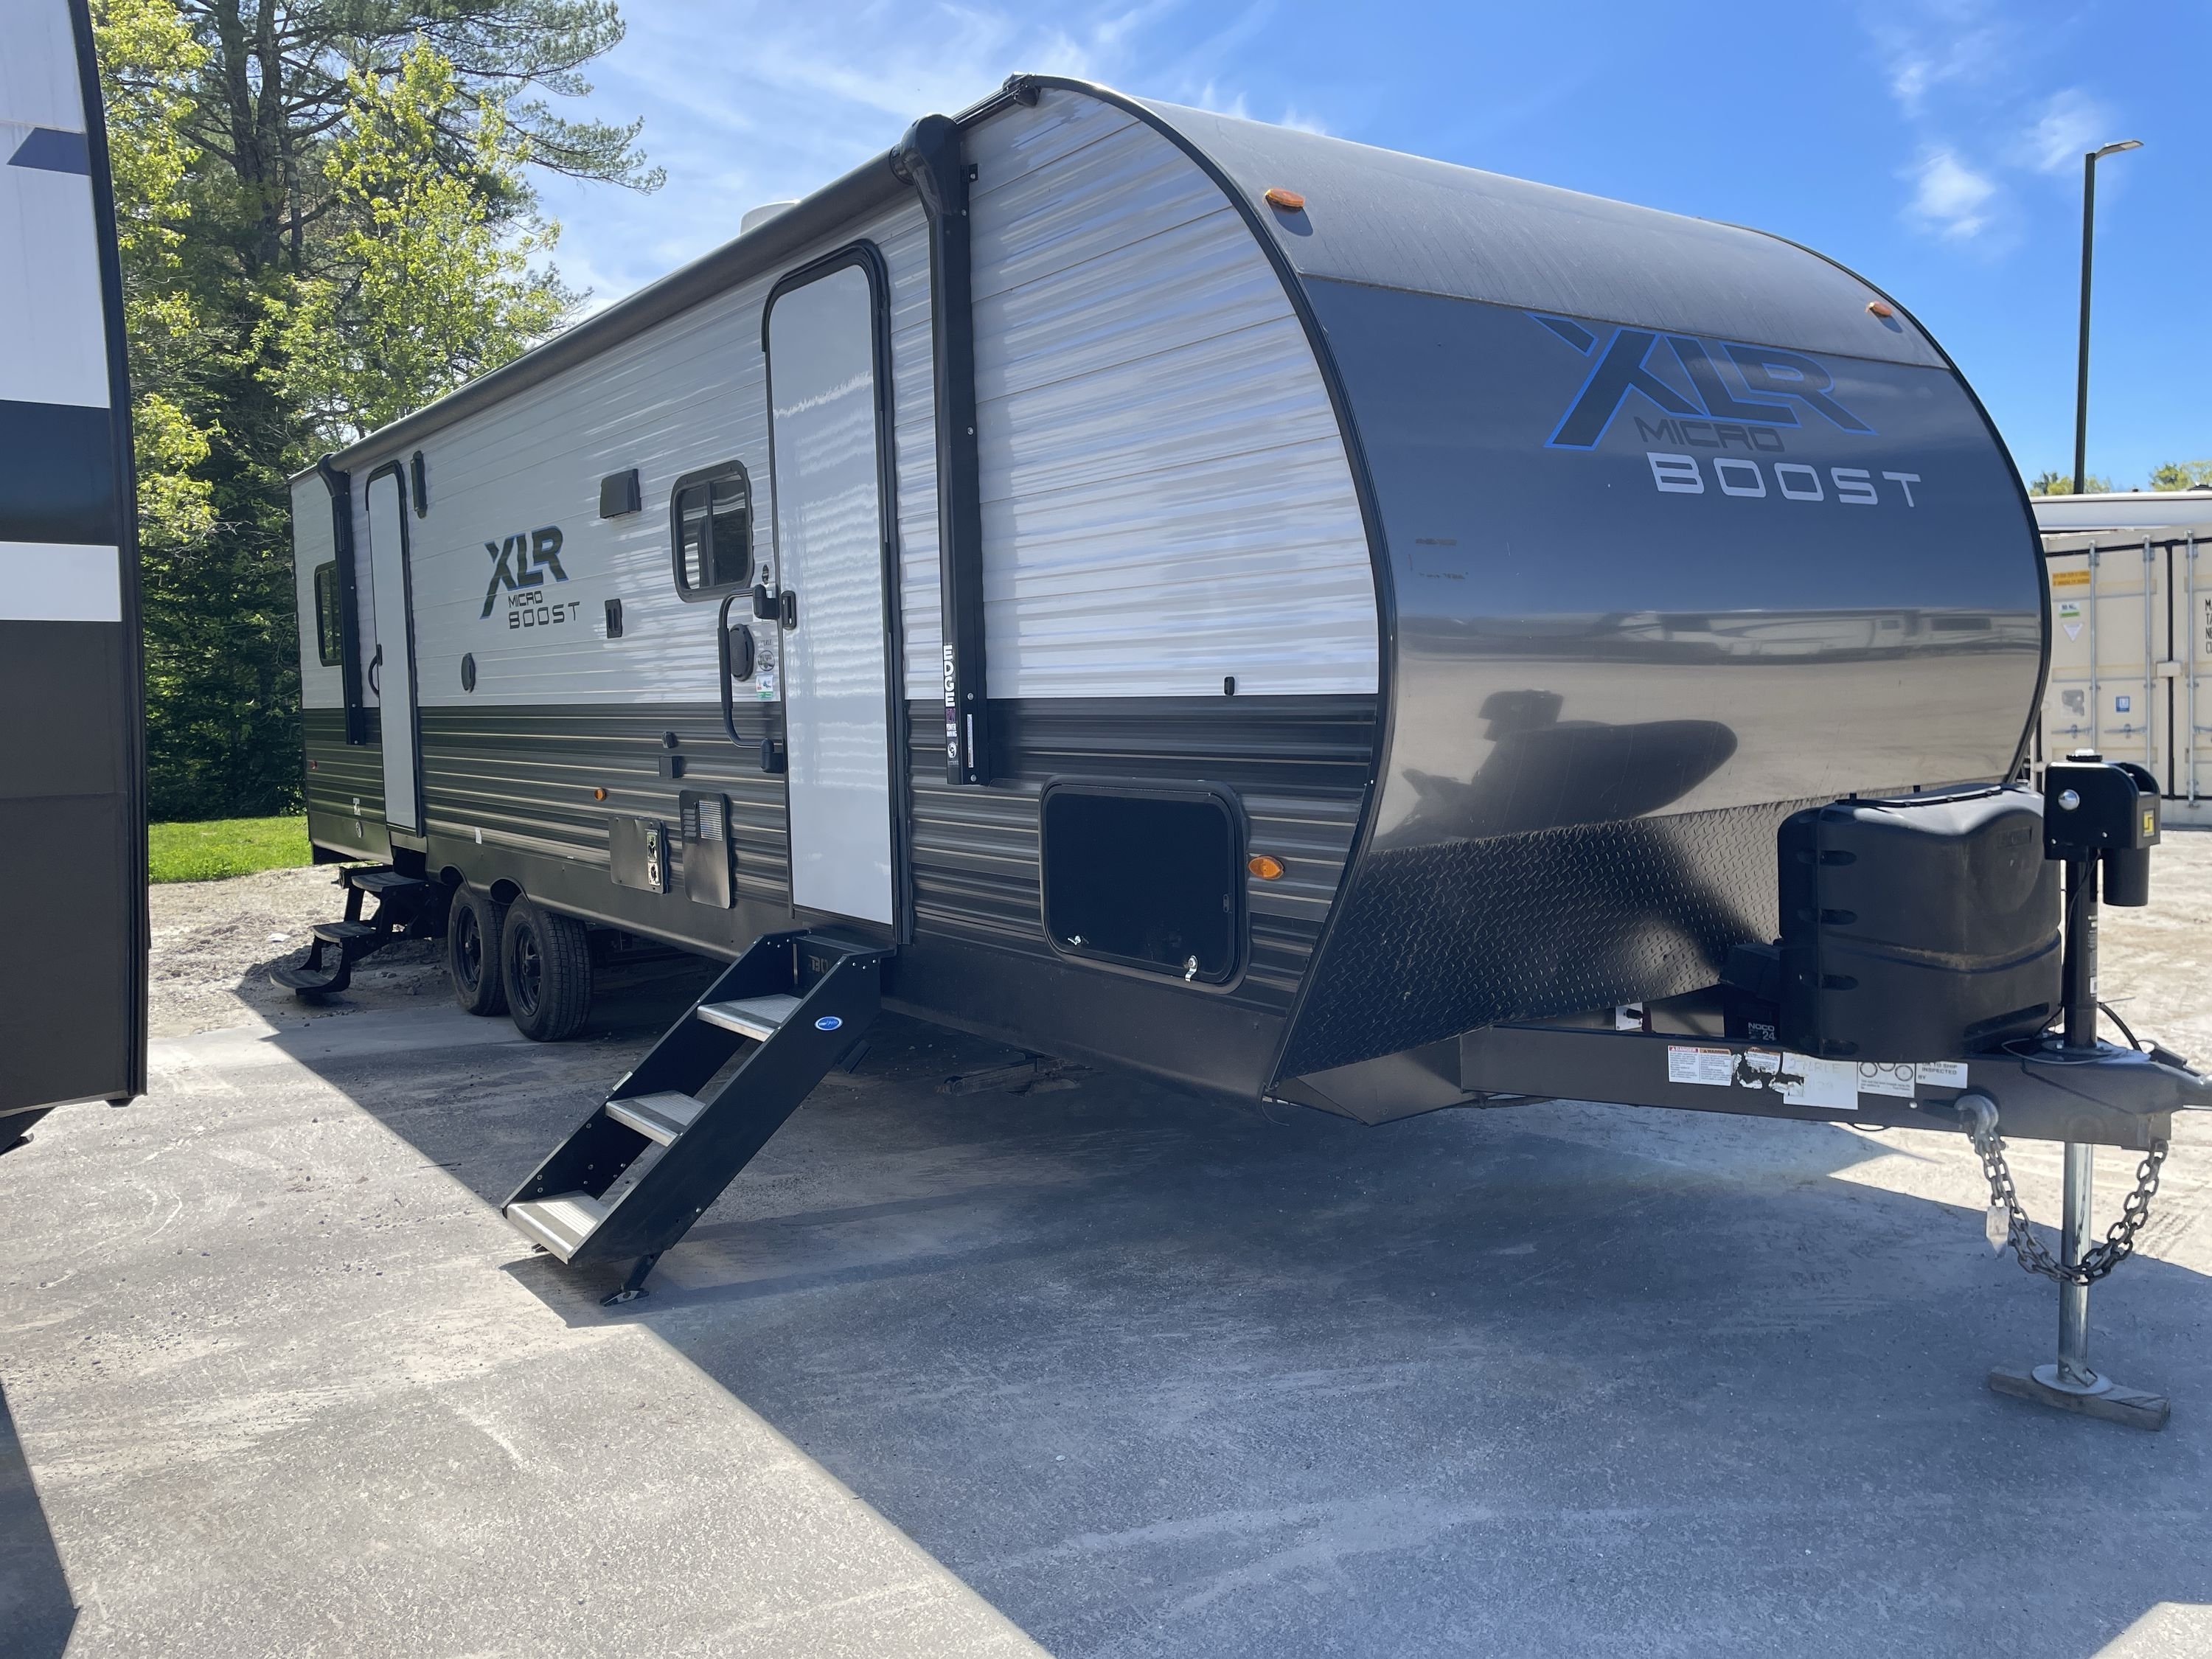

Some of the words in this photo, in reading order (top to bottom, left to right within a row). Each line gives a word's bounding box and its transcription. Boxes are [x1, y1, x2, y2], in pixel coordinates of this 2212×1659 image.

[1523, 310, 1879, 451] XLR
[1633, 416, 1785, 453] MICRO
[1646, 452, 1921, 508] BOOST
[479, 524, 569, 620] XLR
[508, 590, 543, 608] MICRO
[509, 601, 580, 630] BOOST
[943, 644, 956, 707] EDGE
[1747, 1022, 1775, 1032] NOCO
[1762, 1031, 1775, 1041] 24
[1921, 1067, 1958, 1075] INSPECTED
